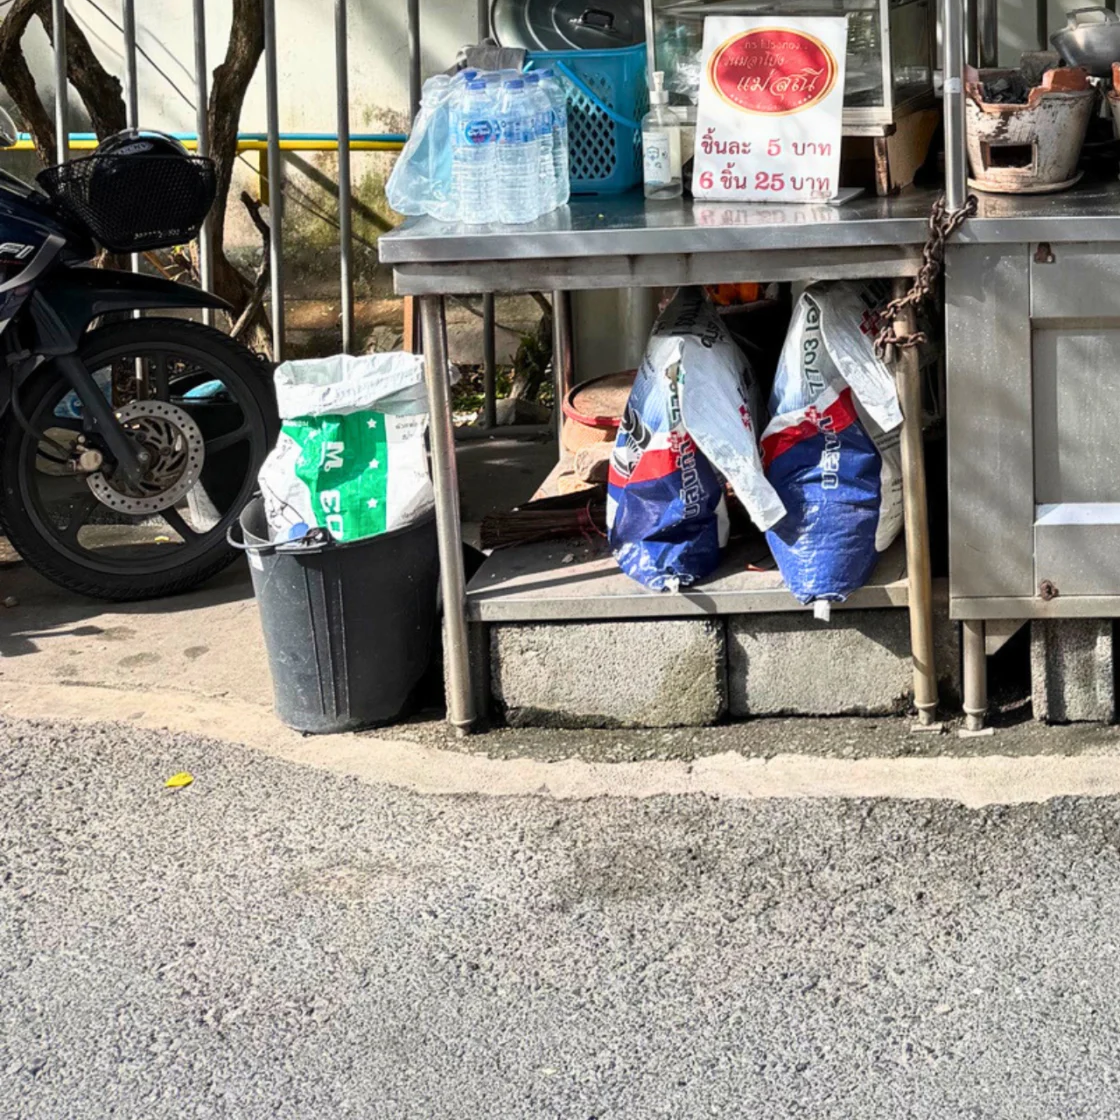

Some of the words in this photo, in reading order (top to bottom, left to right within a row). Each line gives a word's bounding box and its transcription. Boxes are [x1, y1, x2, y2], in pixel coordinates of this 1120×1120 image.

[701, 128, 751, 155] ชิ้นละ
[767, 138, 781, 156] 5
[792, 142, 832, 156] บาท
[700, 171, 714, 190] 6
[720, 162, 747, 190] ชิ้น
[755, 171, 785, 191] 25
[790, 176, 830, 191] บาท
[804, 338, 824, 395] 7703
